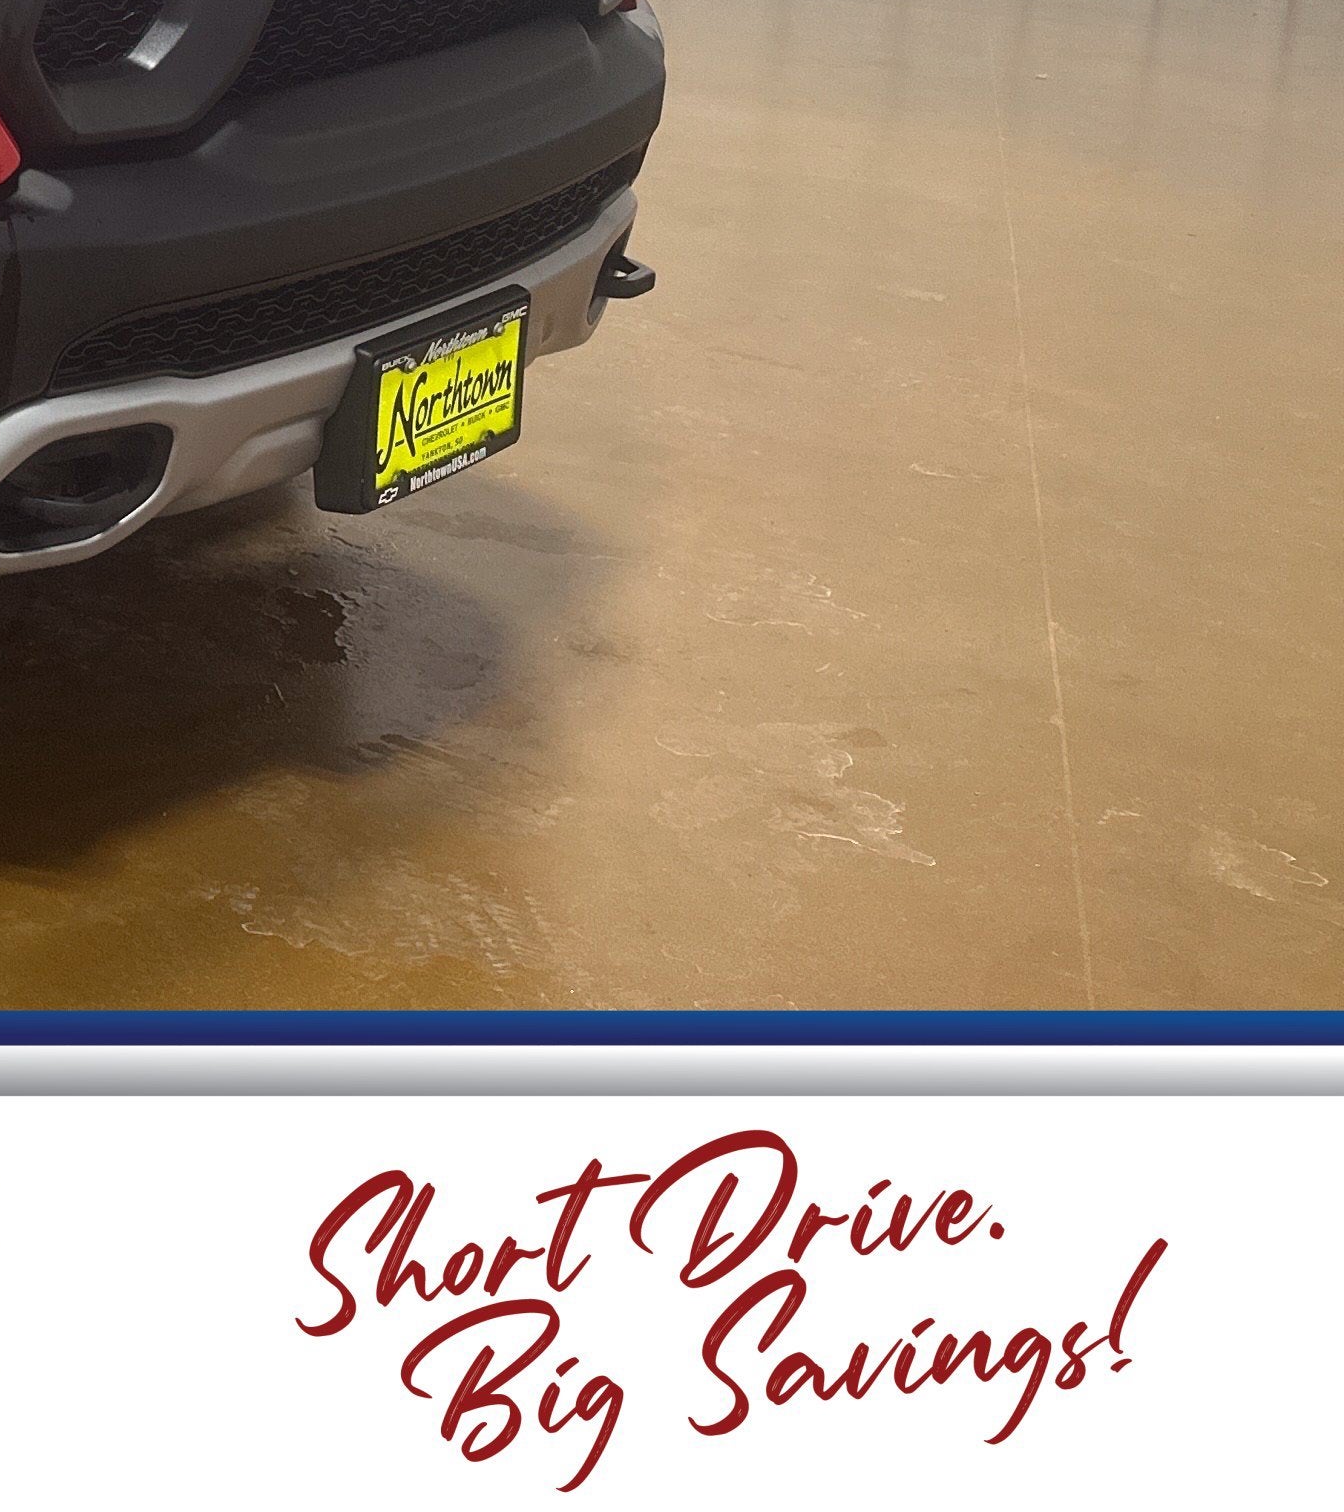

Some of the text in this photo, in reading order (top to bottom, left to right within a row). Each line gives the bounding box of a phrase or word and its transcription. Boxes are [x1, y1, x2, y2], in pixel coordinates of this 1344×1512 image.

[501, 305, 528, 323] GMC
[420, 327, 488, 366] Northtown
[375, 356, 512, 474] Northtown
[410, 446, 487, 492] NorthtownUSA.com
